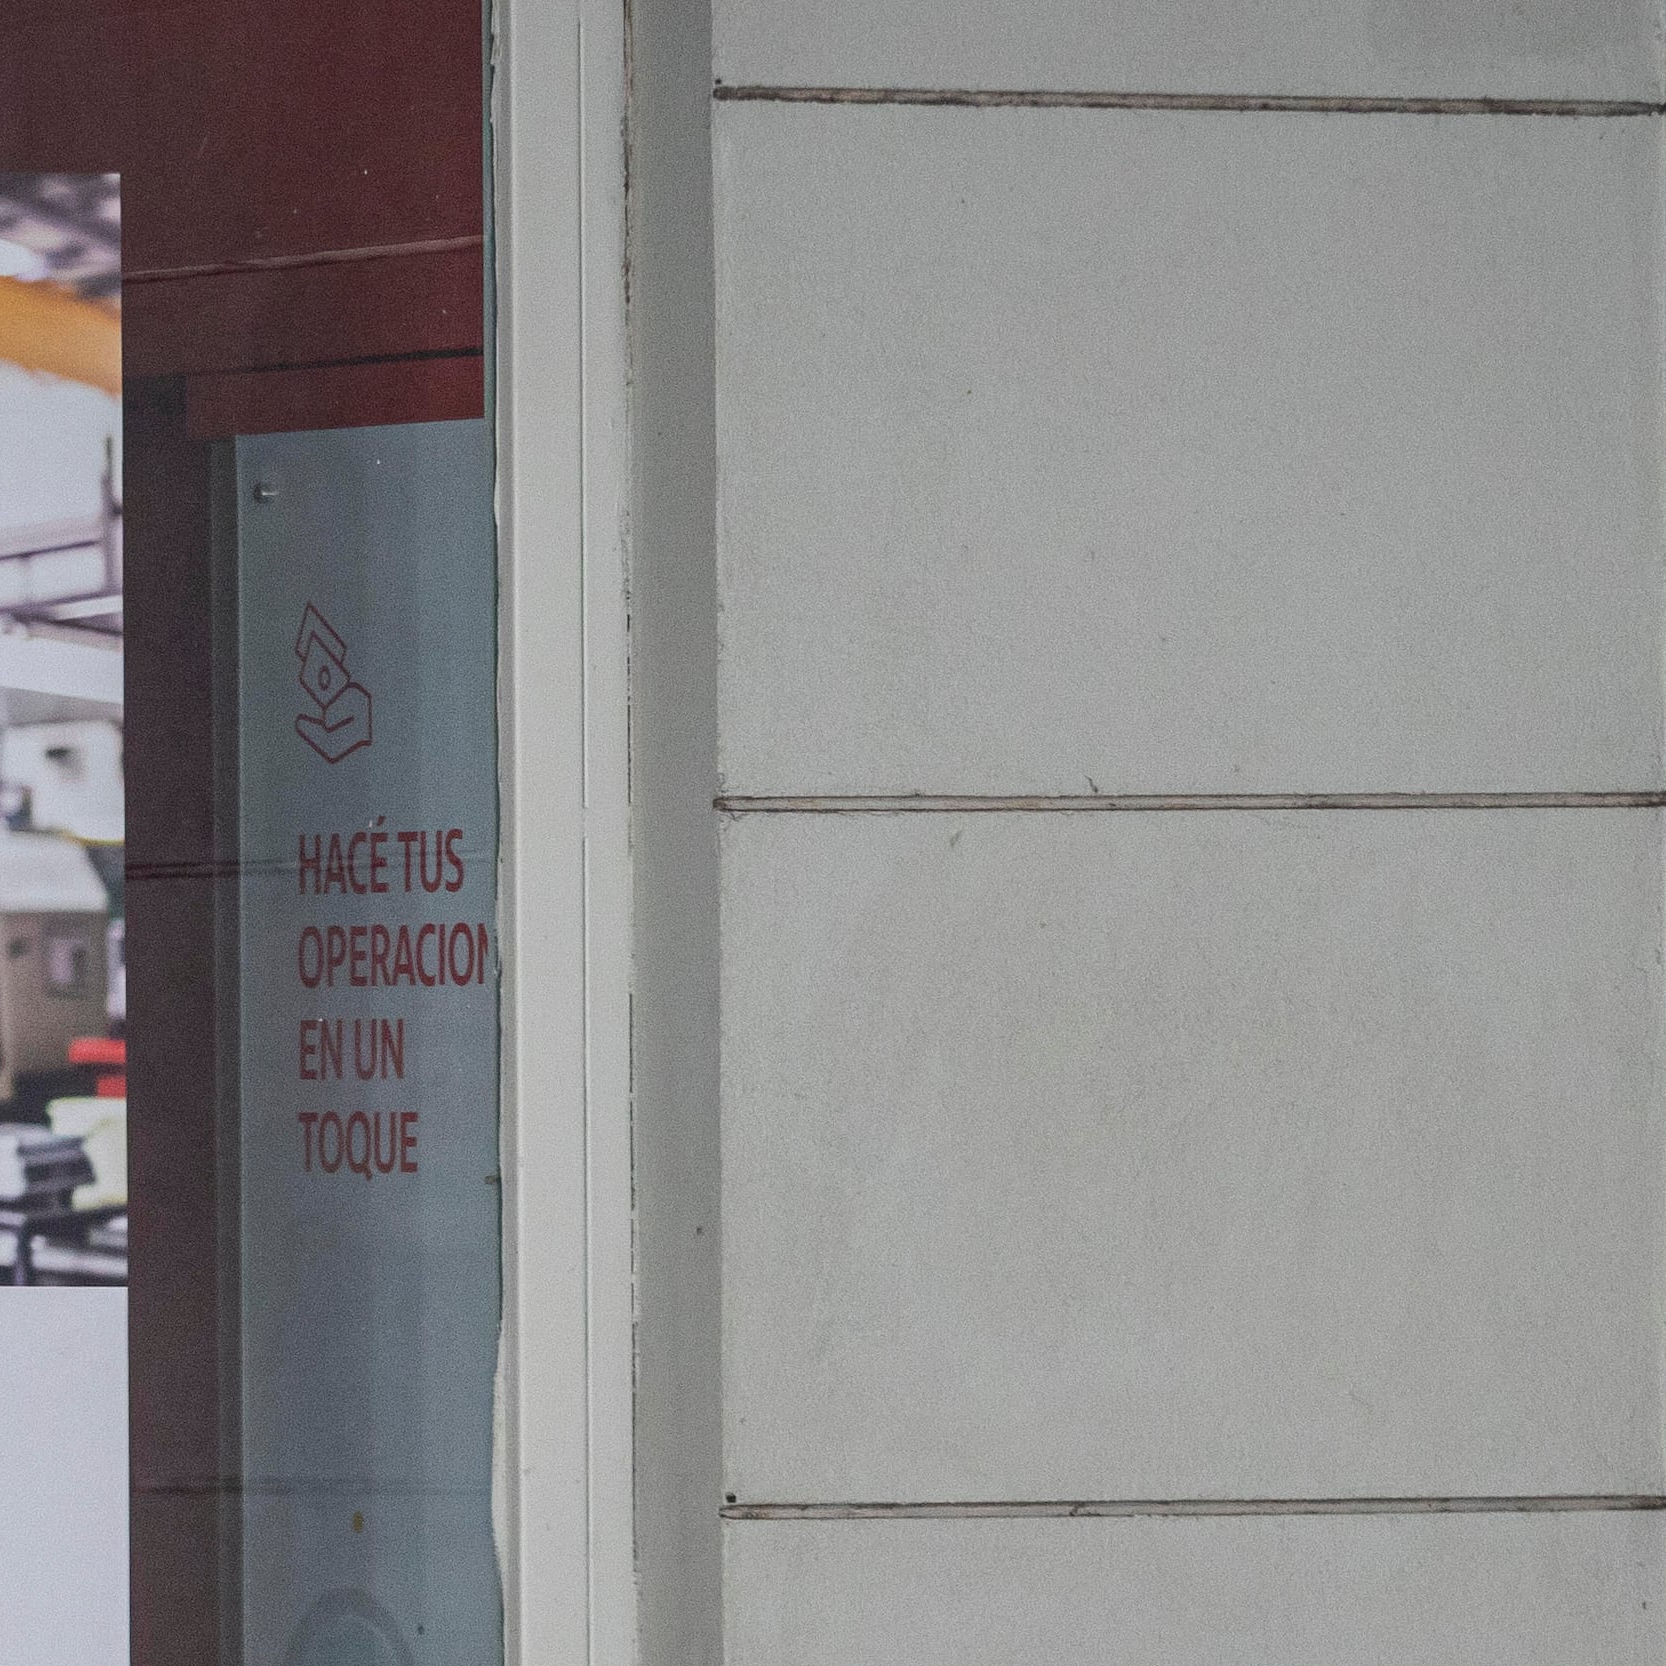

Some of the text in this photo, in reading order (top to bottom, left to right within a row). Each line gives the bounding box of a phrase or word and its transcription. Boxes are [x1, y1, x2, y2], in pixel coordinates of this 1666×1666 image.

[298, 816, 465, 895] HACÉ TUS
[300, 1018, 405, 1081] EN UN
[298, 1110, 419, 1182] TOQUE
